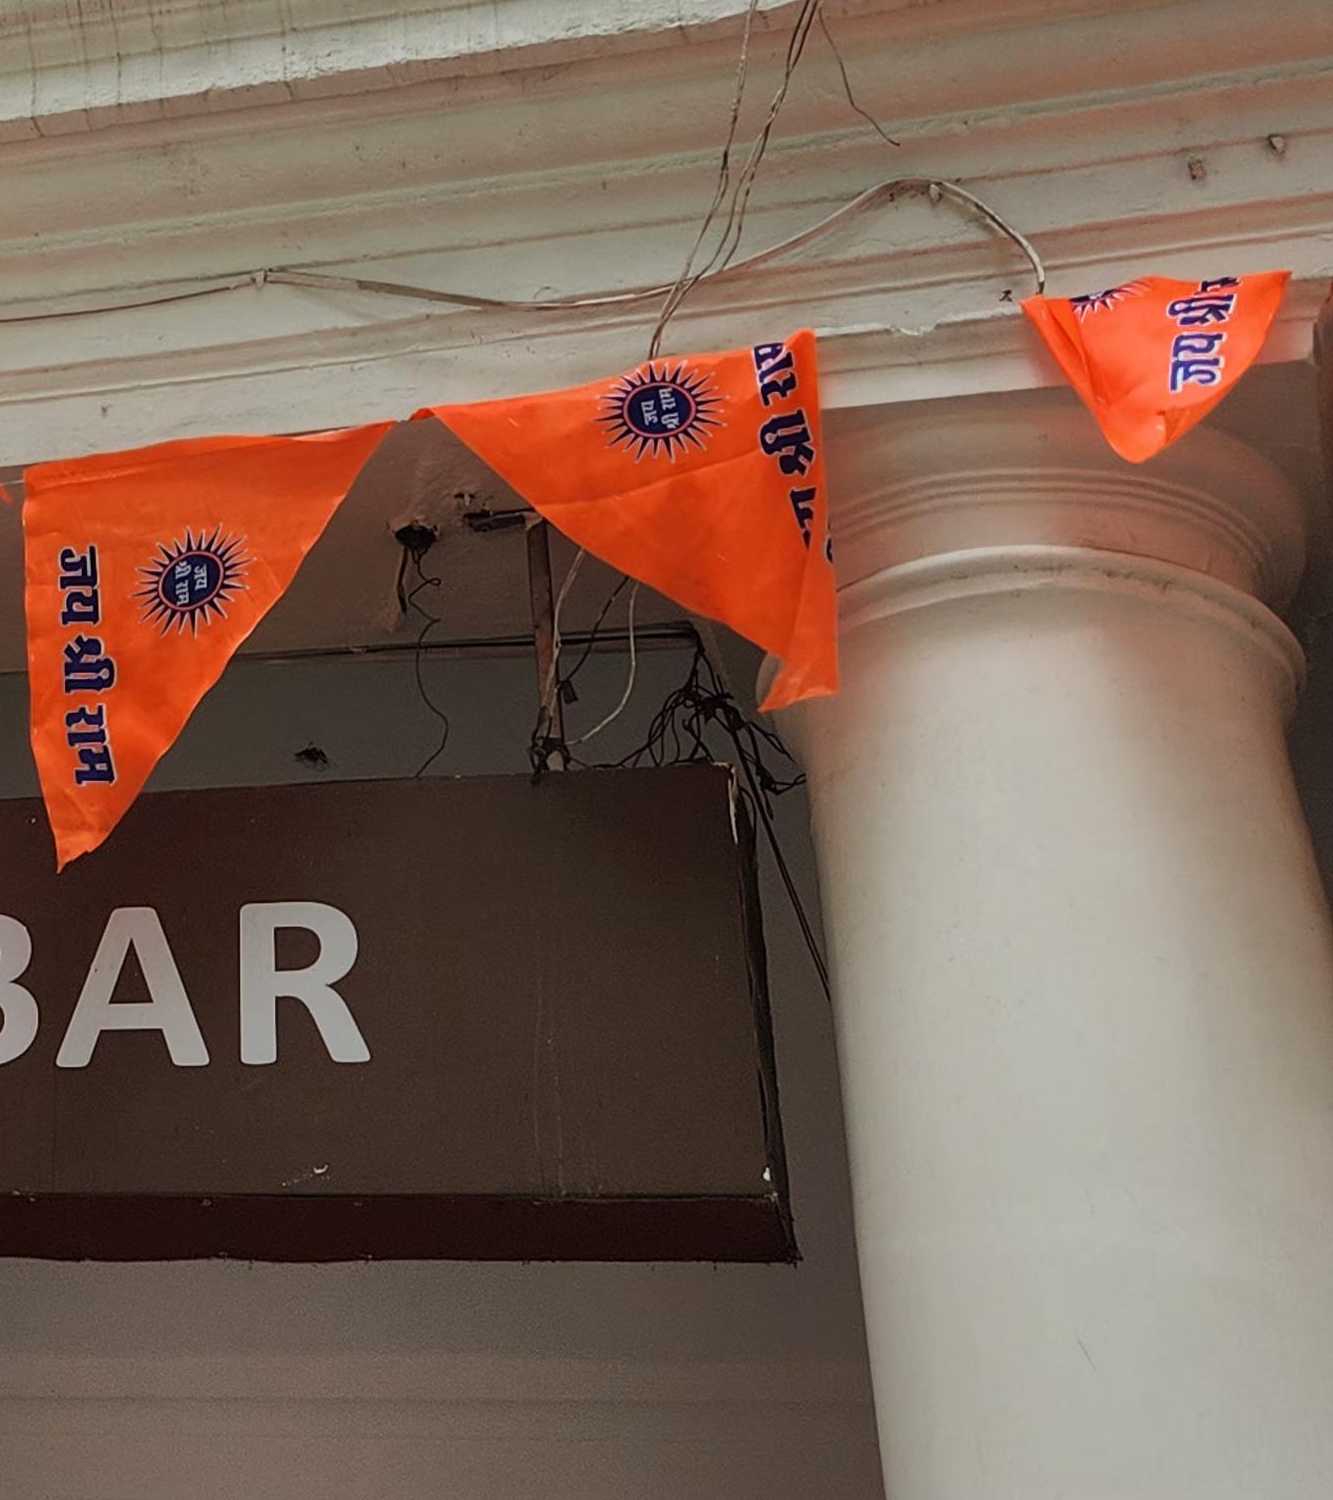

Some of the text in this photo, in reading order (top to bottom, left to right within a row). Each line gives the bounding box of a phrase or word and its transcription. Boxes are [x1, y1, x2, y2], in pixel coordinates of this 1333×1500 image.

[1169, 331, 1226, 393] जय
[758, 409, 817, 479] श्री
[59, 545, 118, 787] जय श्री राम
